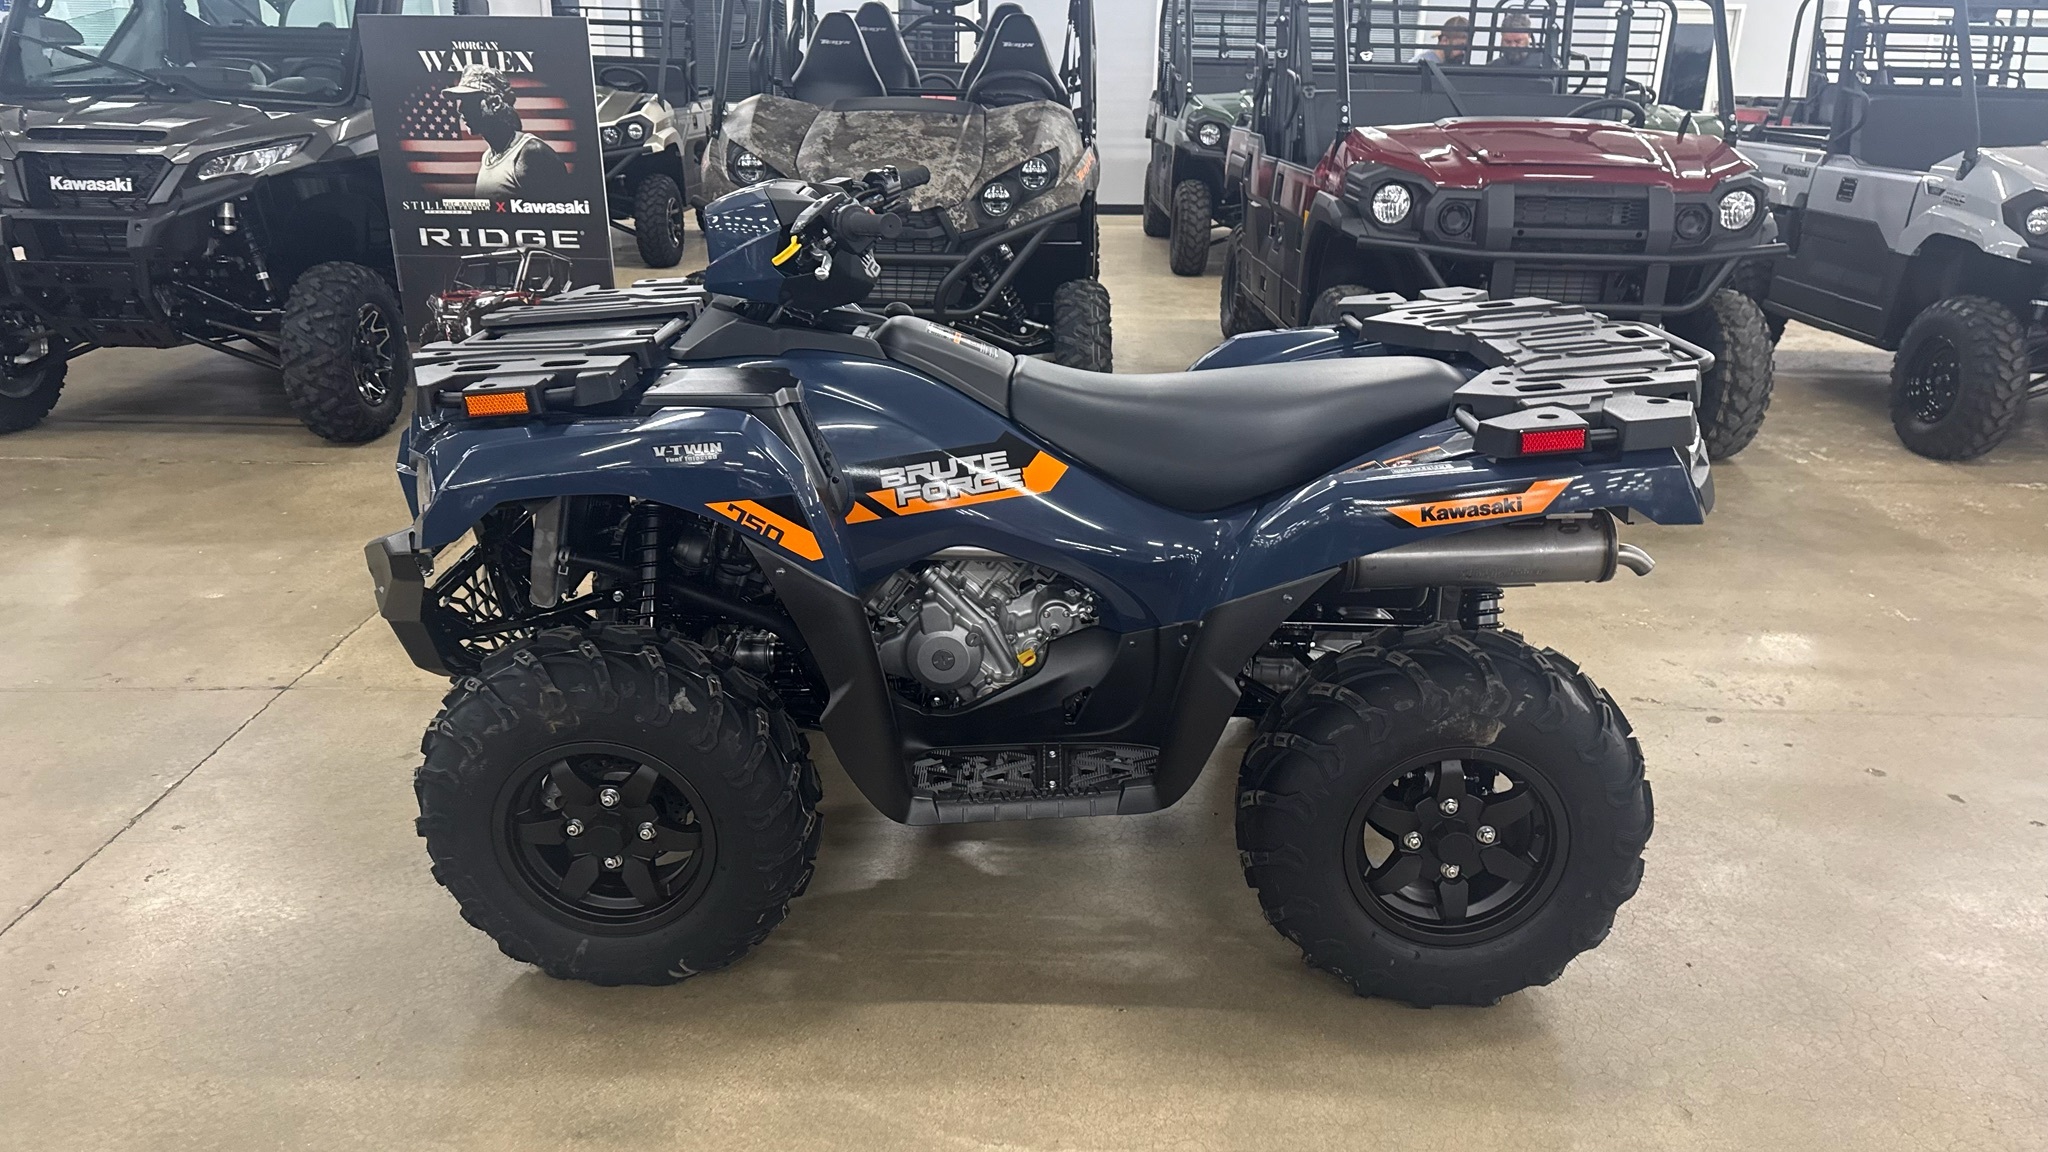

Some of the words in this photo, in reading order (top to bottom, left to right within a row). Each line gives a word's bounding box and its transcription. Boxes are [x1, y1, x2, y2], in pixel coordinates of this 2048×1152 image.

[452, 40, 499, 50] MORGAN
[49, 176, 133, 192] Kawasaki
[402, 201, 442, 210] STILL
[510, 199, 590, 214] Kawasaki
[419, 228, 581, 249] RIDGE
[652, 442, 723, 457] V-TWIN
[665, 454, 683, 463] Fuel
[879, 450, 1010, 488] BRUTE
[895, 468, 1025, 506] FORCE
[1420, 496, 1523, 523] Kawasaki
[727, 503, 785, 545] 750
